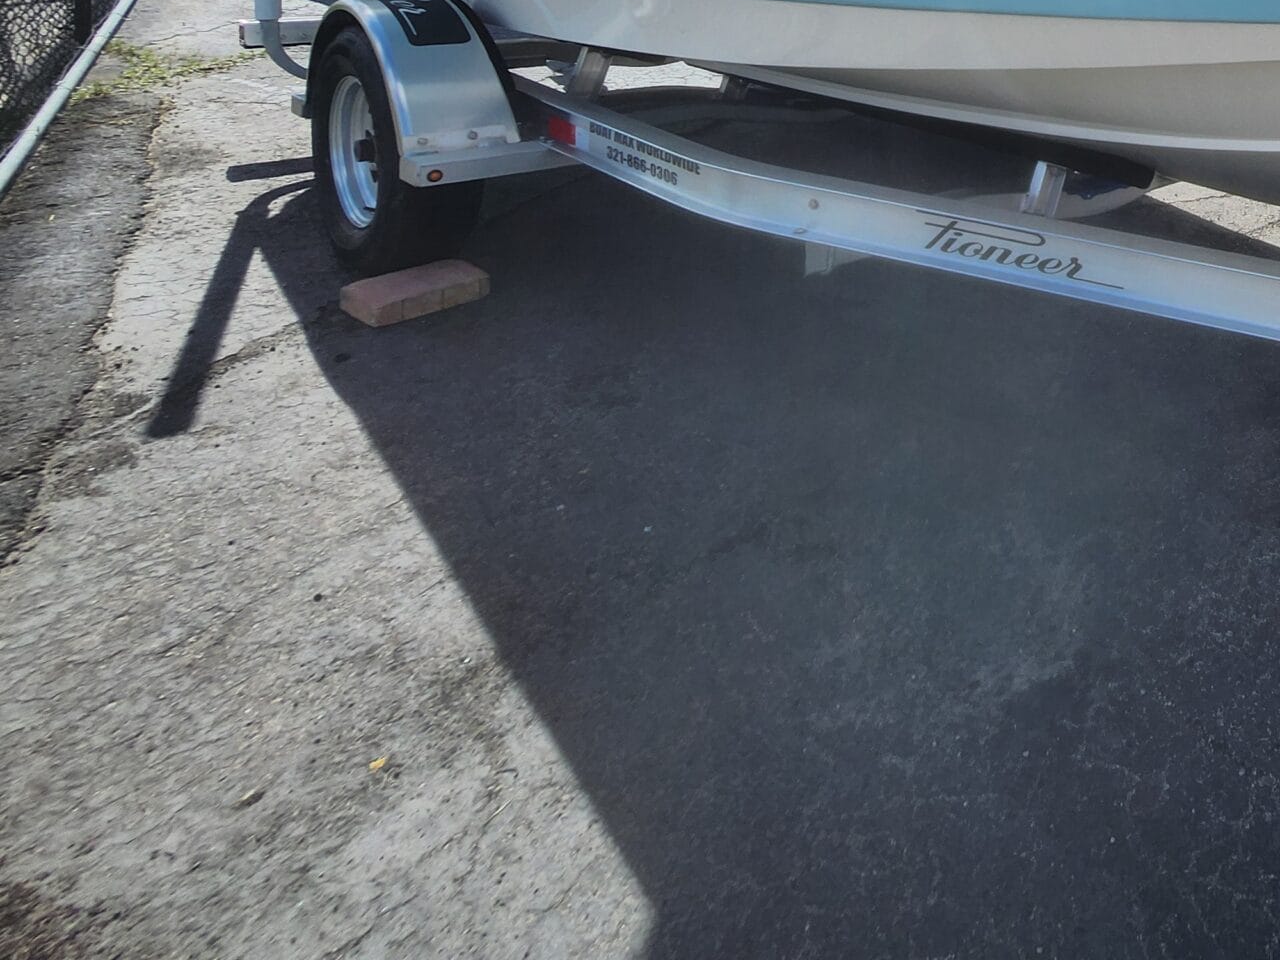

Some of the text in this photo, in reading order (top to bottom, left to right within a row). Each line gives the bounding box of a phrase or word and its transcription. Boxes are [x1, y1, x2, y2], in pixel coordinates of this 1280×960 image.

[613, 131, 635, 150] MAX
[606, 145, 679, 186] 321-866-0306
[915, 209, 1125, 290] Pioneer
